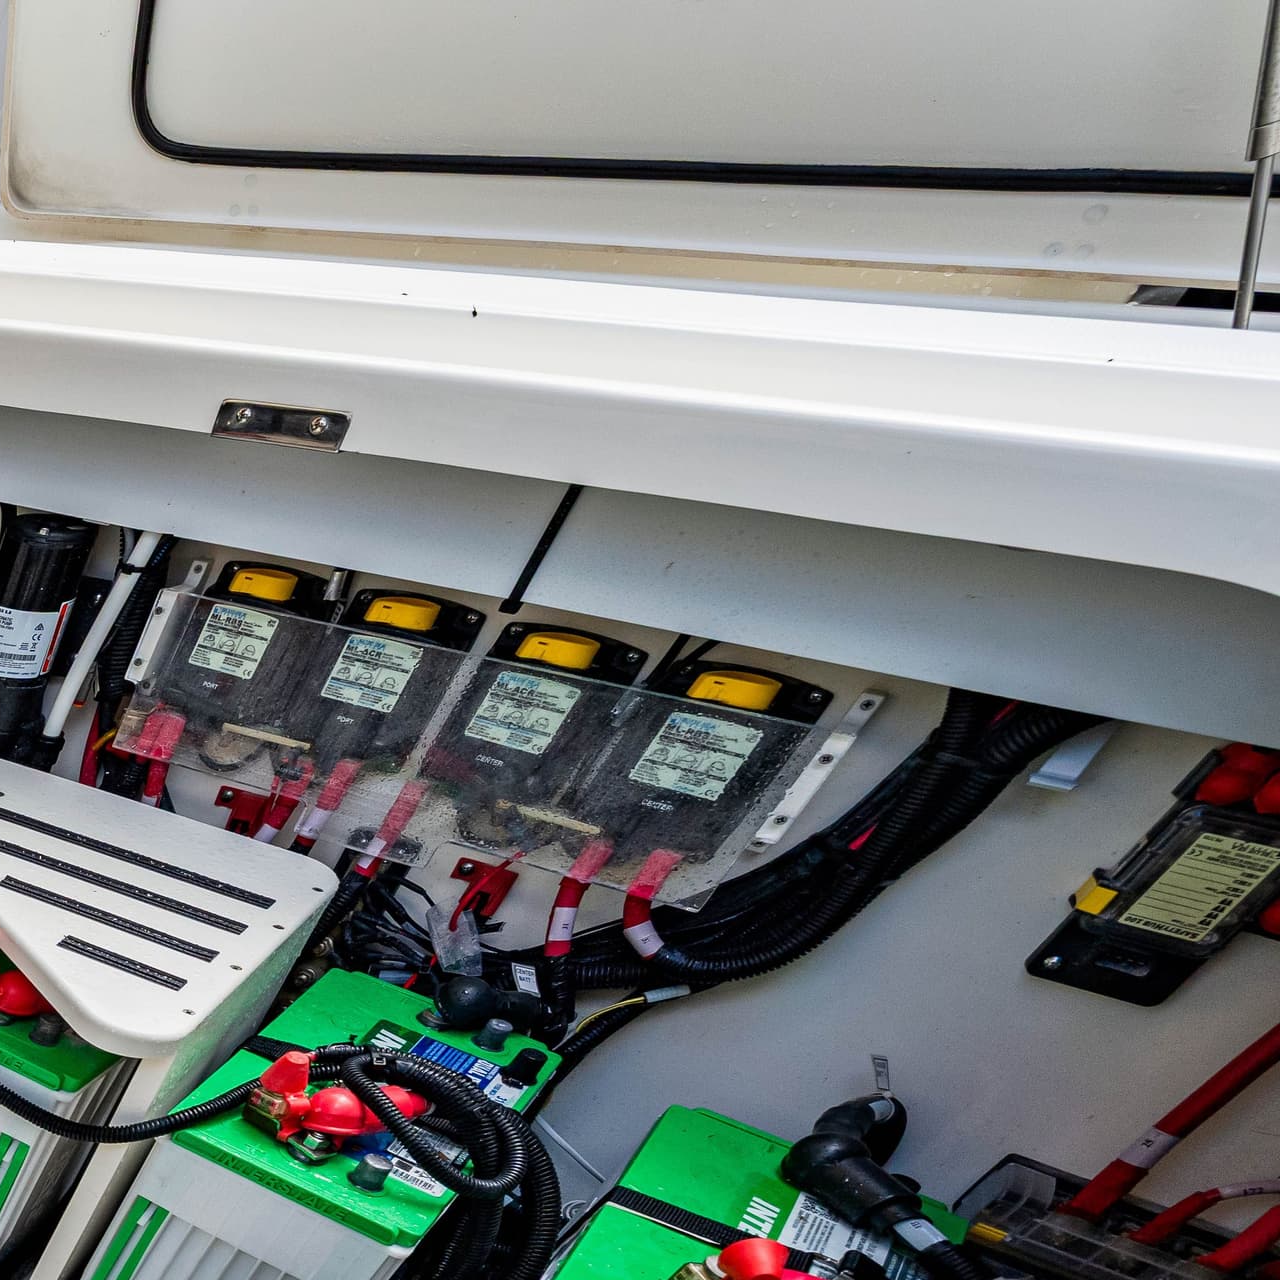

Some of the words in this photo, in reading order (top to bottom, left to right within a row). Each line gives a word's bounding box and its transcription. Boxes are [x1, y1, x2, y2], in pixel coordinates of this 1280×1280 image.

[202, 681, 219, 690] PORT
[337, 715, 355, 725] PORT
[475, 754, 505, 768] CENTER
